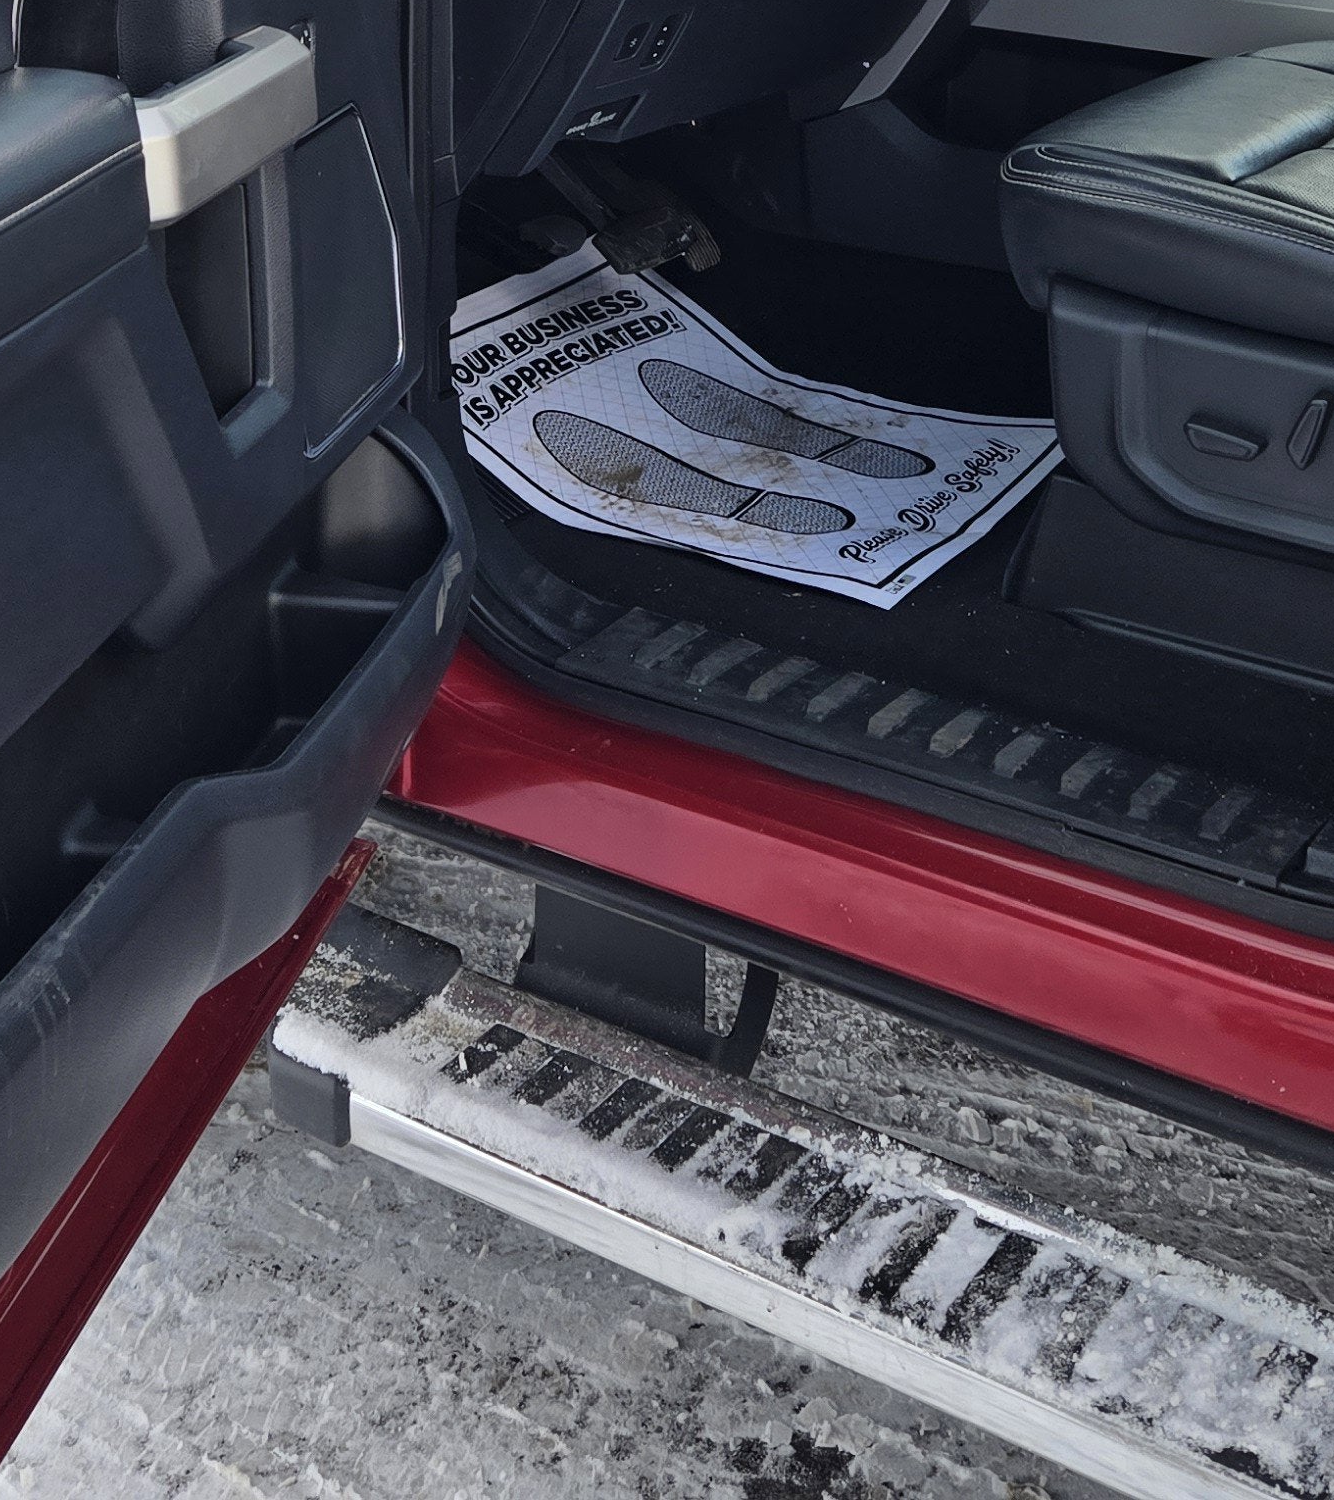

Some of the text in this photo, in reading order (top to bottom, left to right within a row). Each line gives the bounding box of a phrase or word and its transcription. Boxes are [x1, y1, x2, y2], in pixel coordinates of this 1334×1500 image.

[450, 289, 645, 389] OUR BUSINESS
[462, 310, 682, 429] IS APPRECIATED!
[838, 527, 907, 564] Please
[897, 491, 955, 533] Drive
